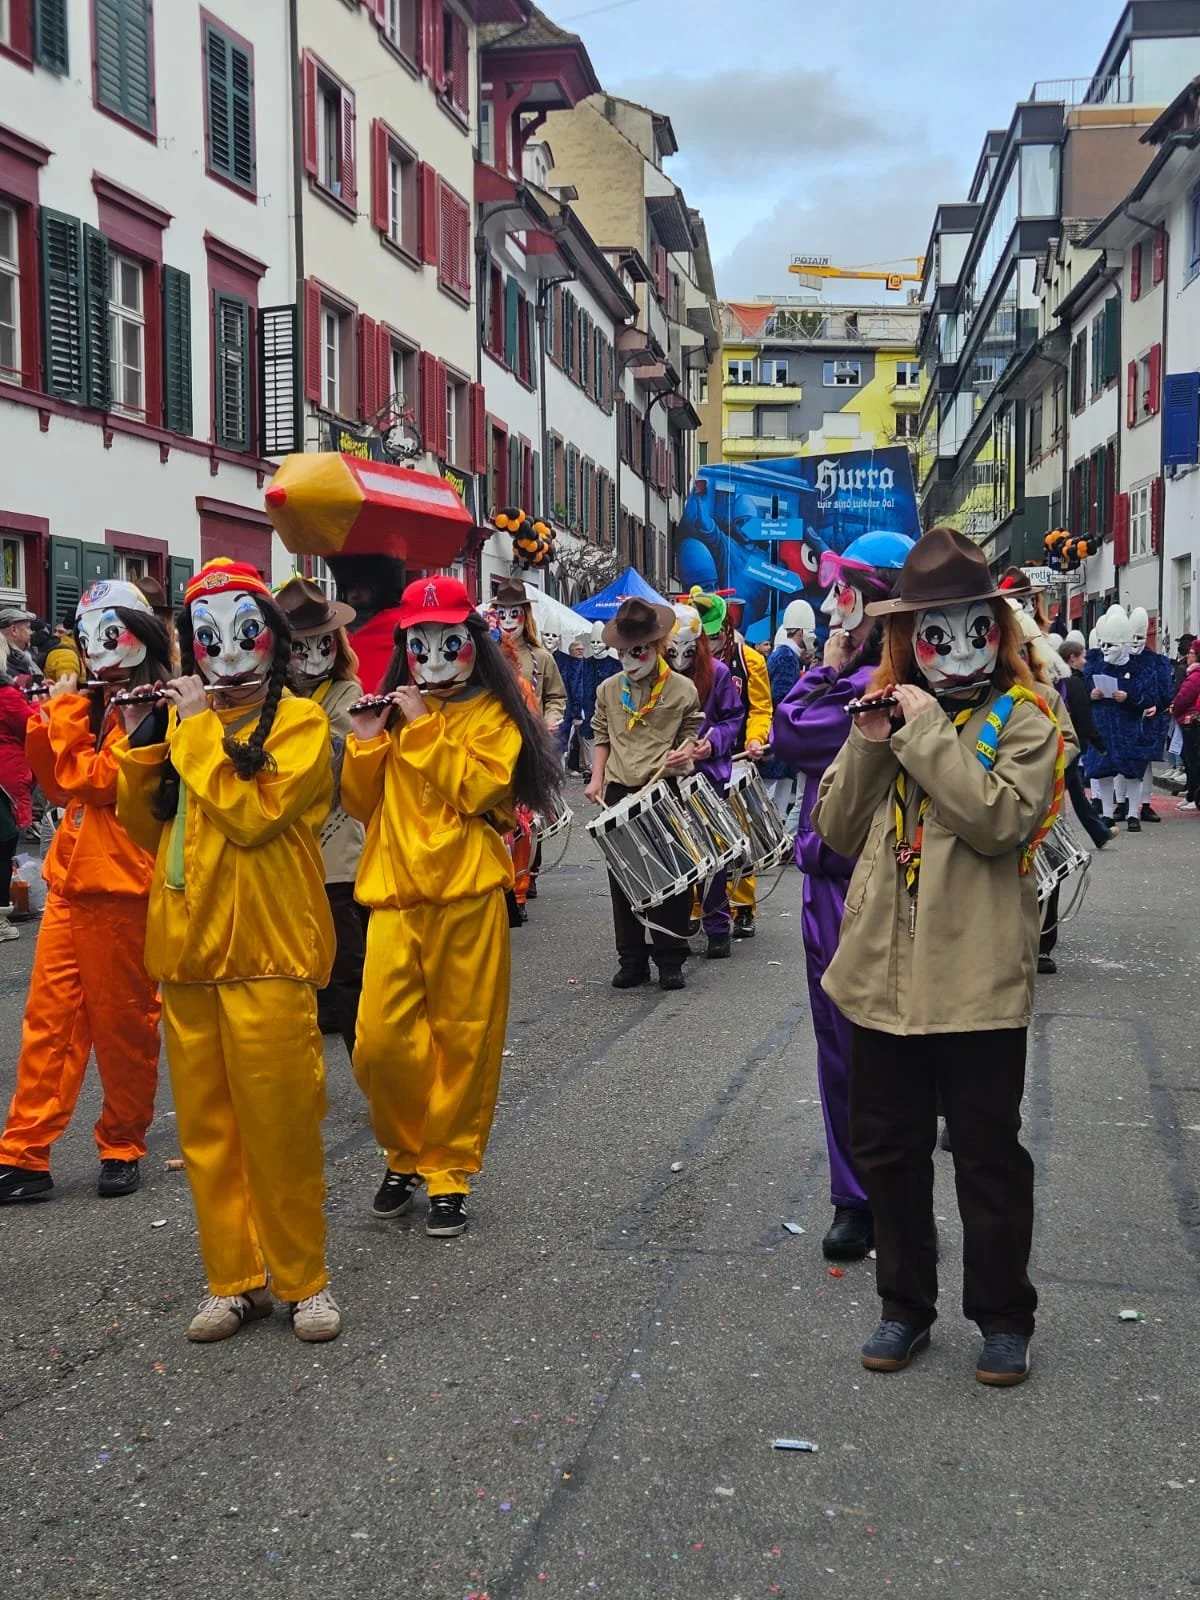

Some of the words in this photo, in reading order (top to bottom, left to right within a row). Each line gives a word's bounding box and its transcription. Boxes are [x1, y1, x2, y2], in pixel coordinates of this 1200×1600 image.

[794, 256, 829, 265] POTAIN
[814, 459, 895, 500] Hurra
[817, 499, 832, 508] wir
[833, 498, 852, 508] sind
[853, 498, 881, 508] wieder
